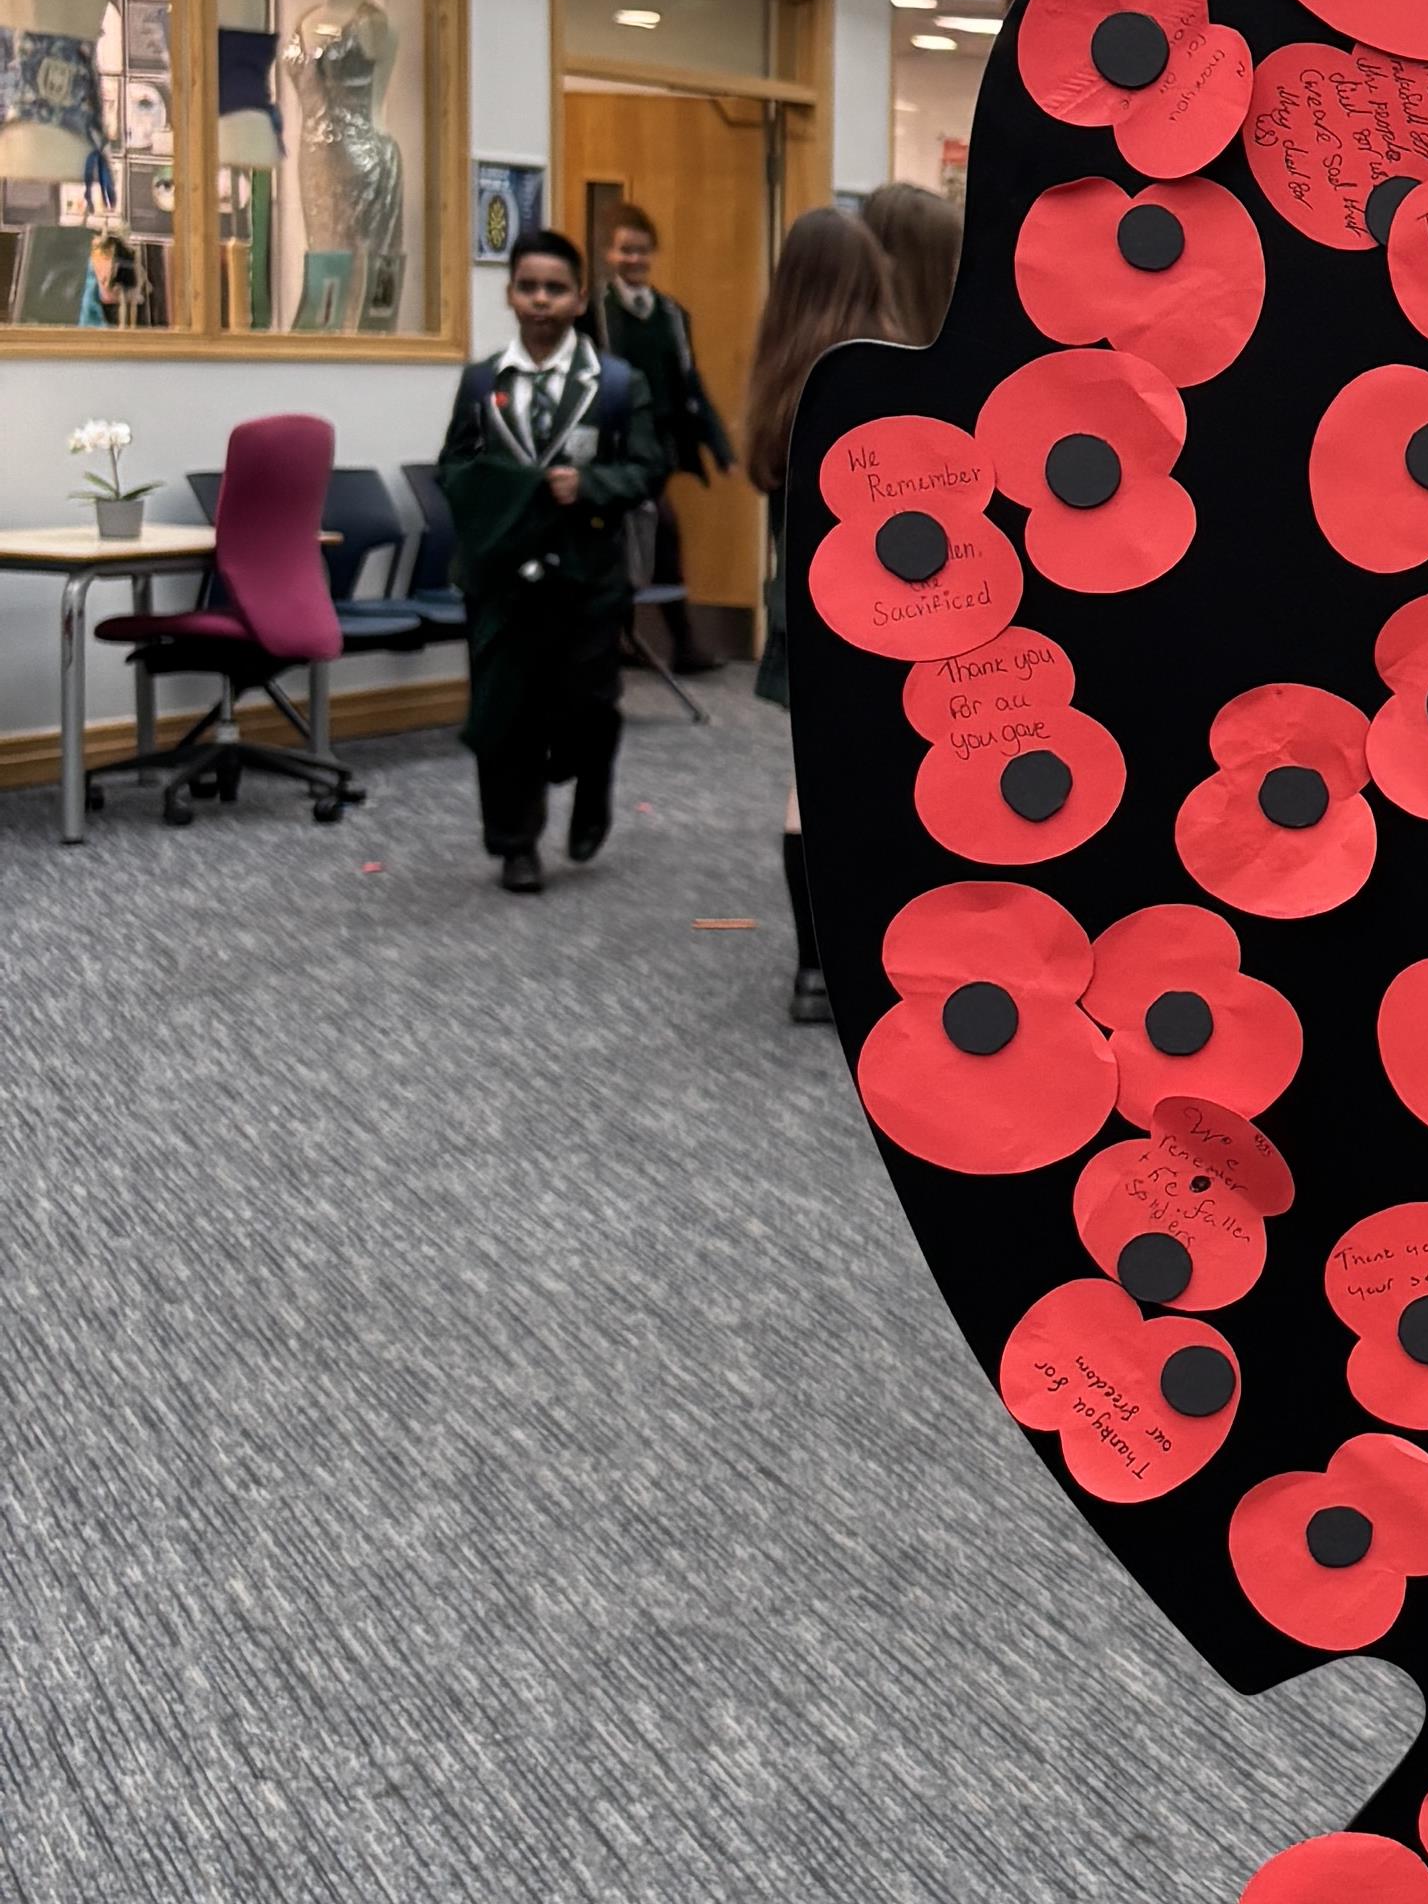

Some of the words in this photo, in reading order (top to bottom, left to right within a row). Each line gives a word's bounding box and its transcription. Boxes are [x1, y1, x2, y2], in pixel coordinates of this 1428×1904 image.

[848, 447, 880, 473] We
[868, 464, 982, 502] Remember
[1014, 648, 1056, 682] you
[950, 732, 999, 761] you
[1000, 721, 1051, 758] gave
[1076, 1356, 1139, 1421] freedom
[1145, 1427, 1171, 1451] our
